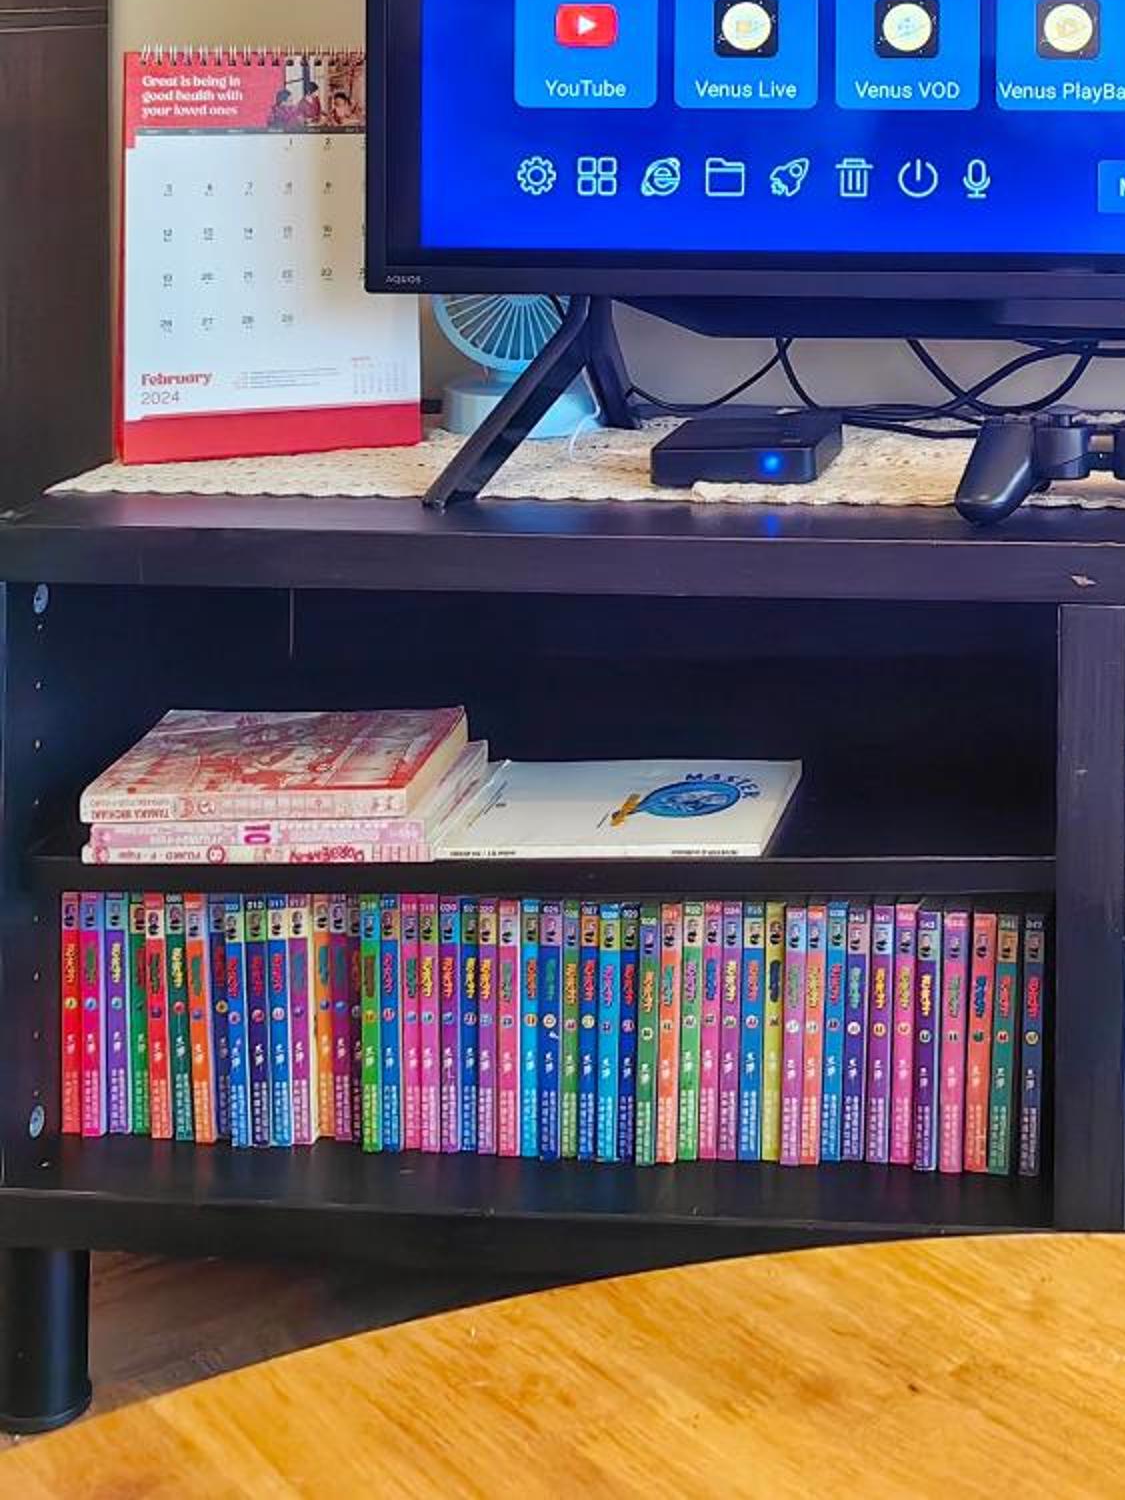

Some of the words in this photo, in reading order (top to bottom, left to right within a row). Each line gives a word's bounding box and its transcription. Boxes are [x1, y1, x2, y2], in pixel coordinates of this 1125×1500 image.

[142, 75, 178, 87] Great
[180, 75, 191, 87] is
[193, 75, 227, 90] being
[229, 75, 241, 87] in
[545, 79, 627, 98] YouTube
[695, 80, 753, 99] Venus
[758, 80, 798, 99] Live
[855, 81, 913, 100] Venus
[918, 81, 960, 100] VOD
[142, 90, 173, 103] good
[175, 90, 214, 101] health
[217, 90, 243, 101] with
[998, 82, 1057, 101] Venus
[142, 106, 172, 118] your
[174, 105, 207, 116] loved
[209, 107, 238, 116] ones
[141, 371, 214, 388] February
[140, 391, 181, 405] 2024
